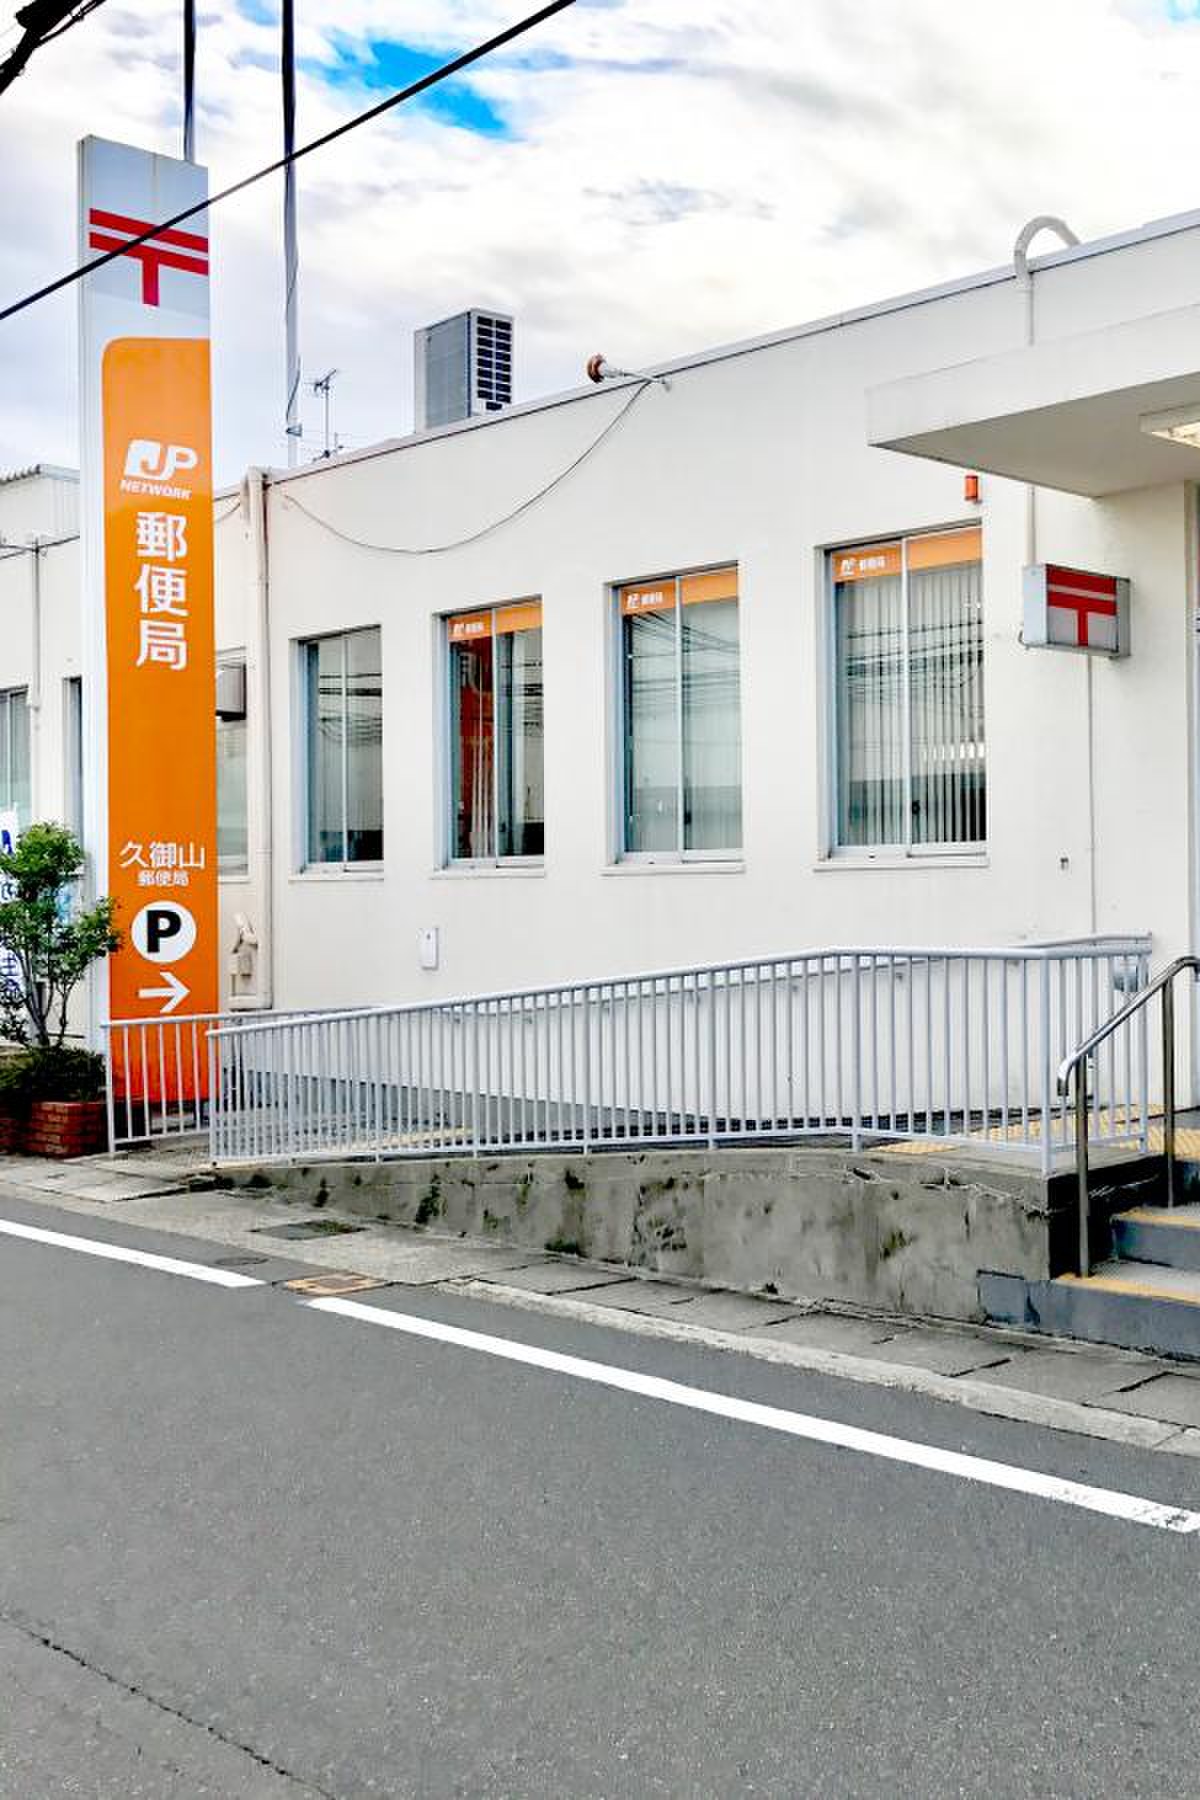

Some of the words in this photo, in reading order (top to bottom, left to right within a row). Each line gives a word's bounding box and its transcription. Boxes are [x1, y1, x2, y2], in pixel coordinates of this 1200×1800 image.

[122, 438, 199, 481] JP
[119, 479, 192, 500] NETWORK
[133, 510, 189, 671] 郵便局
[119, 841, 206, 870] 久御山
[136, 870, 190, 888] 郵便局
[146, 909, 182, 953] P
